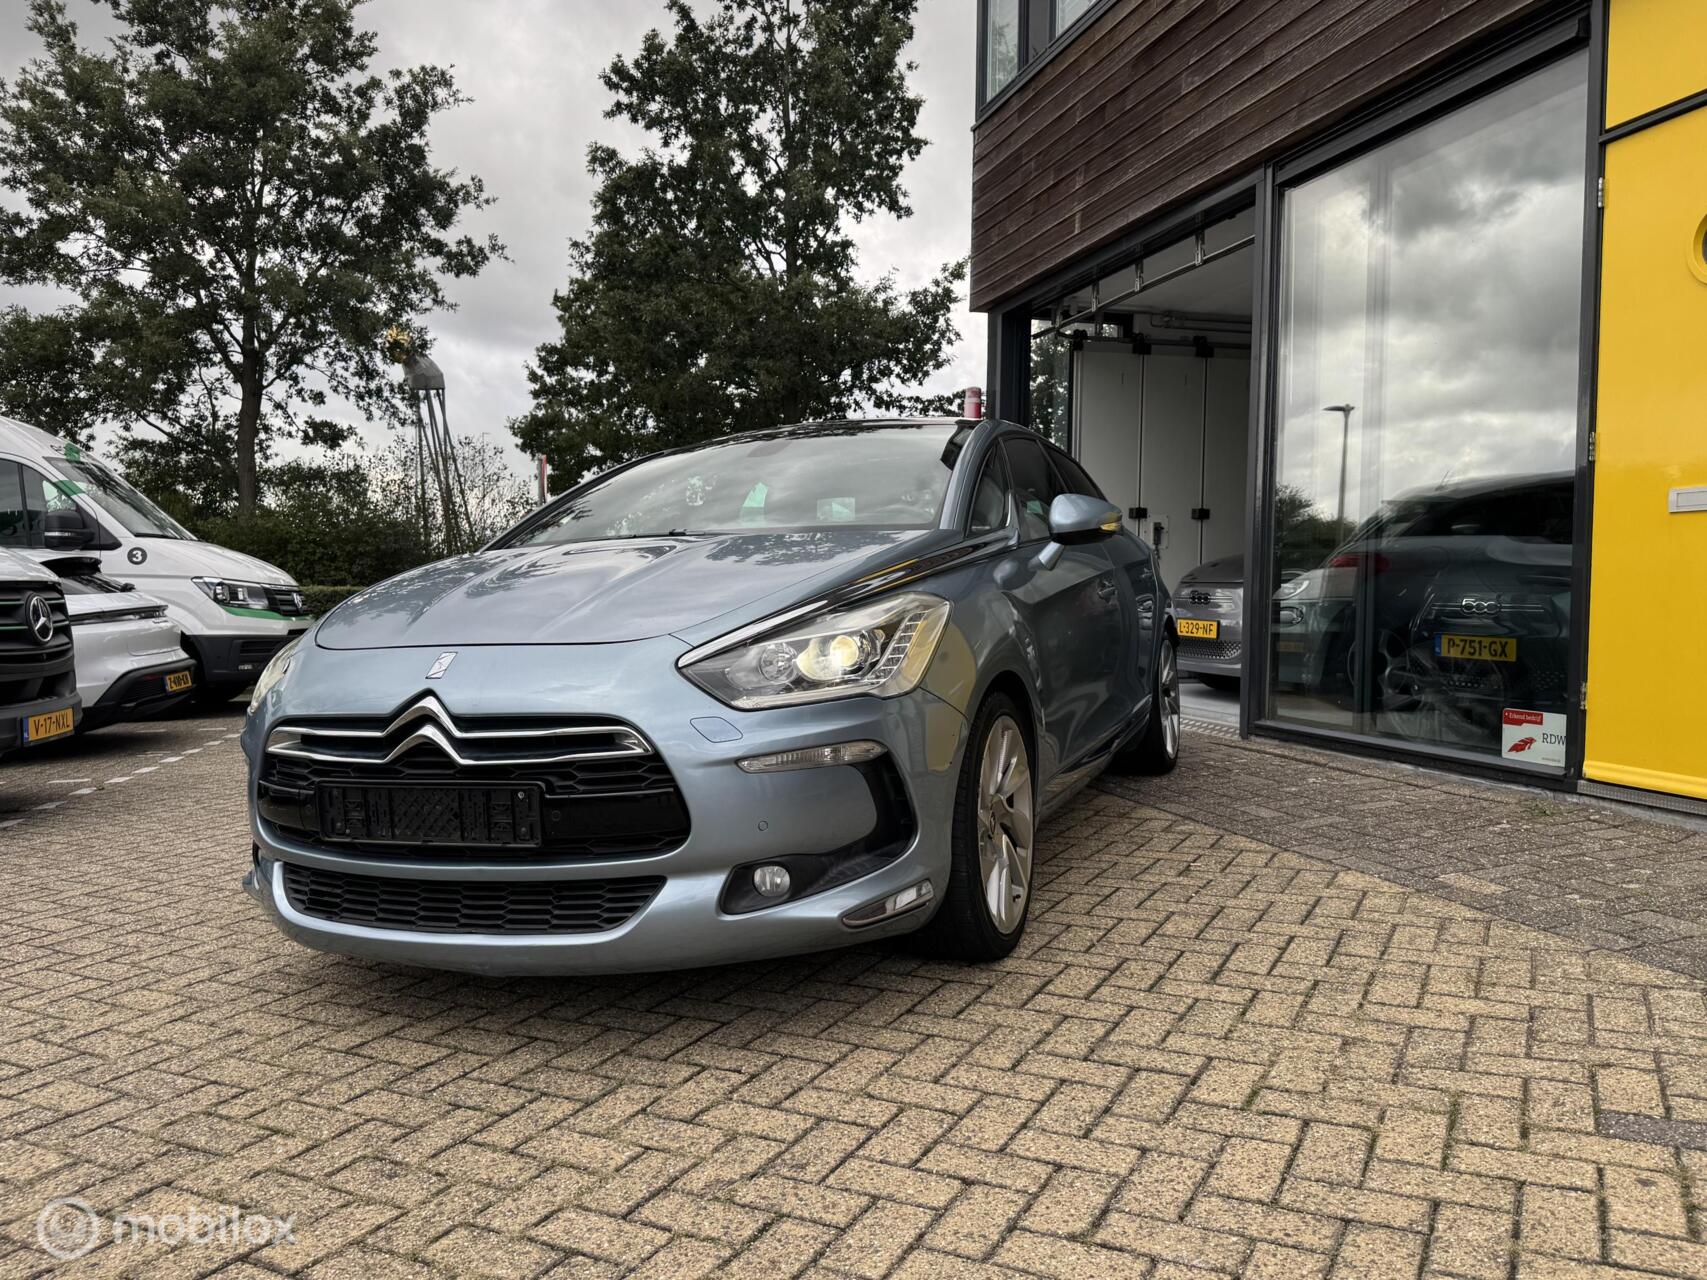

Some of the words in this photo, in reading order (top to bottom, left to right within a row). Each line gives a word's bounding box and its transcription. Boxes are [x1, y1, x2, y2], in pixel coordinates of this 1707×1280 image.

[132, 550, 143, 562] 3
[1462, 598, 1501, 614] 500
[1179, 620, 1214, 636] L-329-NF
[1447, 637, 1509, 658] P-751-GX
[33, 711, 71, 737] V-17-NXL
[1542, 732, 1566, 746] RDW
